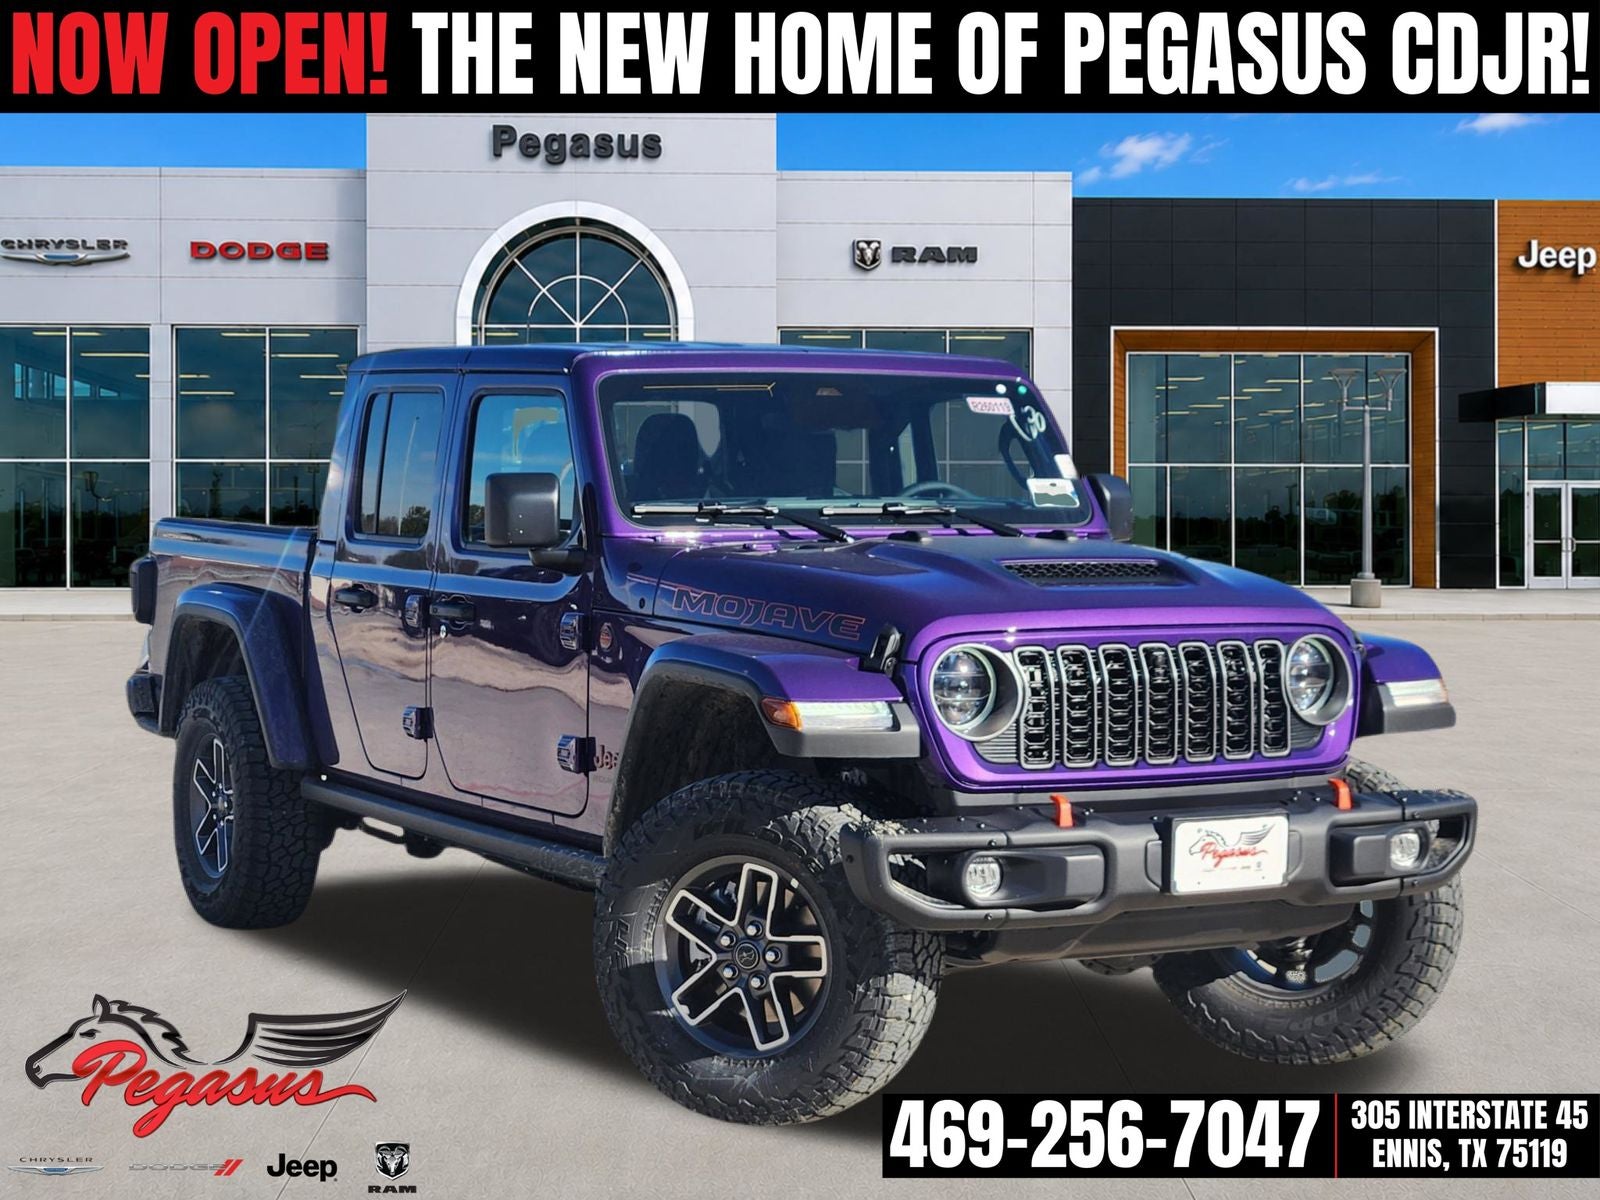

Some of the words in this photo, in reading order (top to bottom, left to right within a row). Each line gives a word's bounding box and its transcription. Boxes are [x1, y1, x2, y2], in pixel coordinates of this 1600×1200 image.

[492, 125, 663, 165] Pegasus
[1, 239, 128, 250] CHRYSLER
[190, 241, 329, 260] DODGE
[891, 246, 978, 263] RAM
[1518, 239, 1597, 275] Jeep
[672, 587, 866, 641] MOJAVE
[1199, 840, 1269, 869] Pegasus
